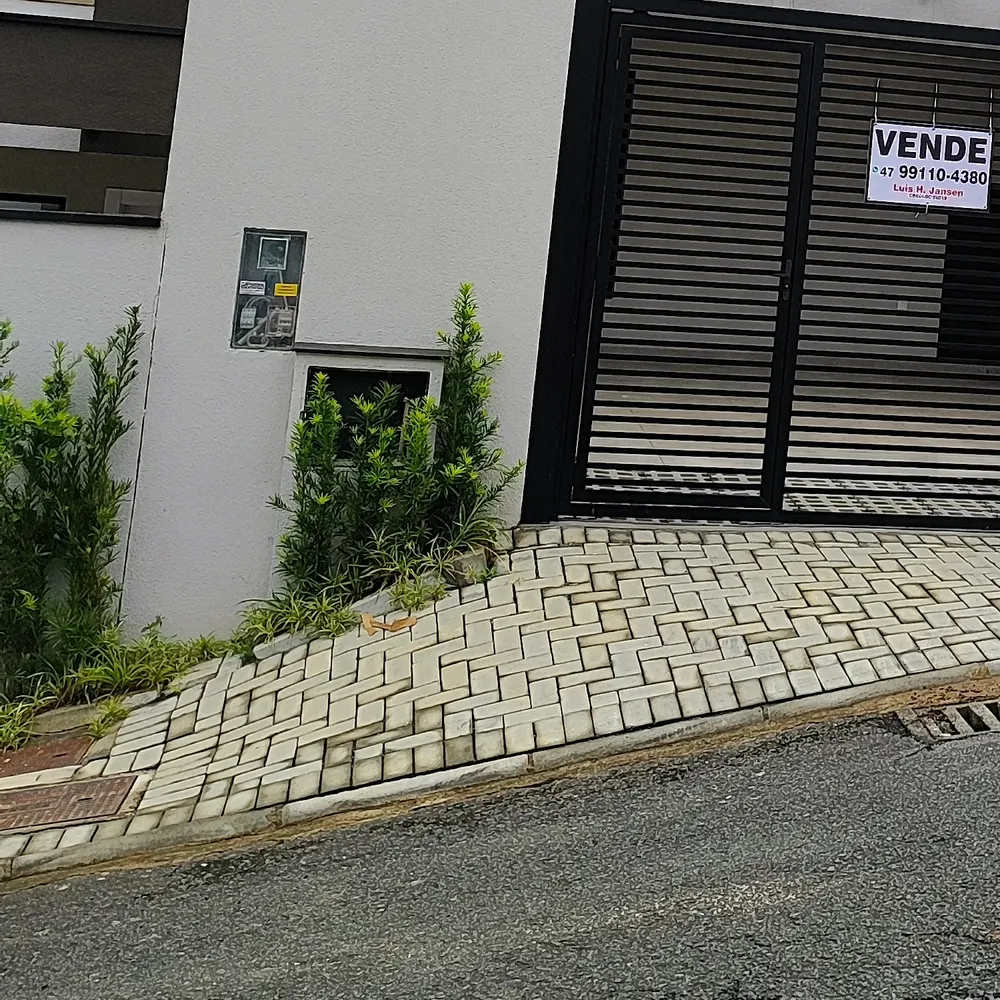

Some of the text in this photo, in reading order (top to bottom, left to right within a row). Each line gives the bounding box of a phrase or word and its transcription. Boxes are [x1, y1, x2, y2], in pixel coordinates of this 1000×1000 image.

[875, 129, 988, 164] VENDE
[880, 165, 988, 185] 47 99110-4380
[893, 183, 964, 197] Luis H. Jansen
